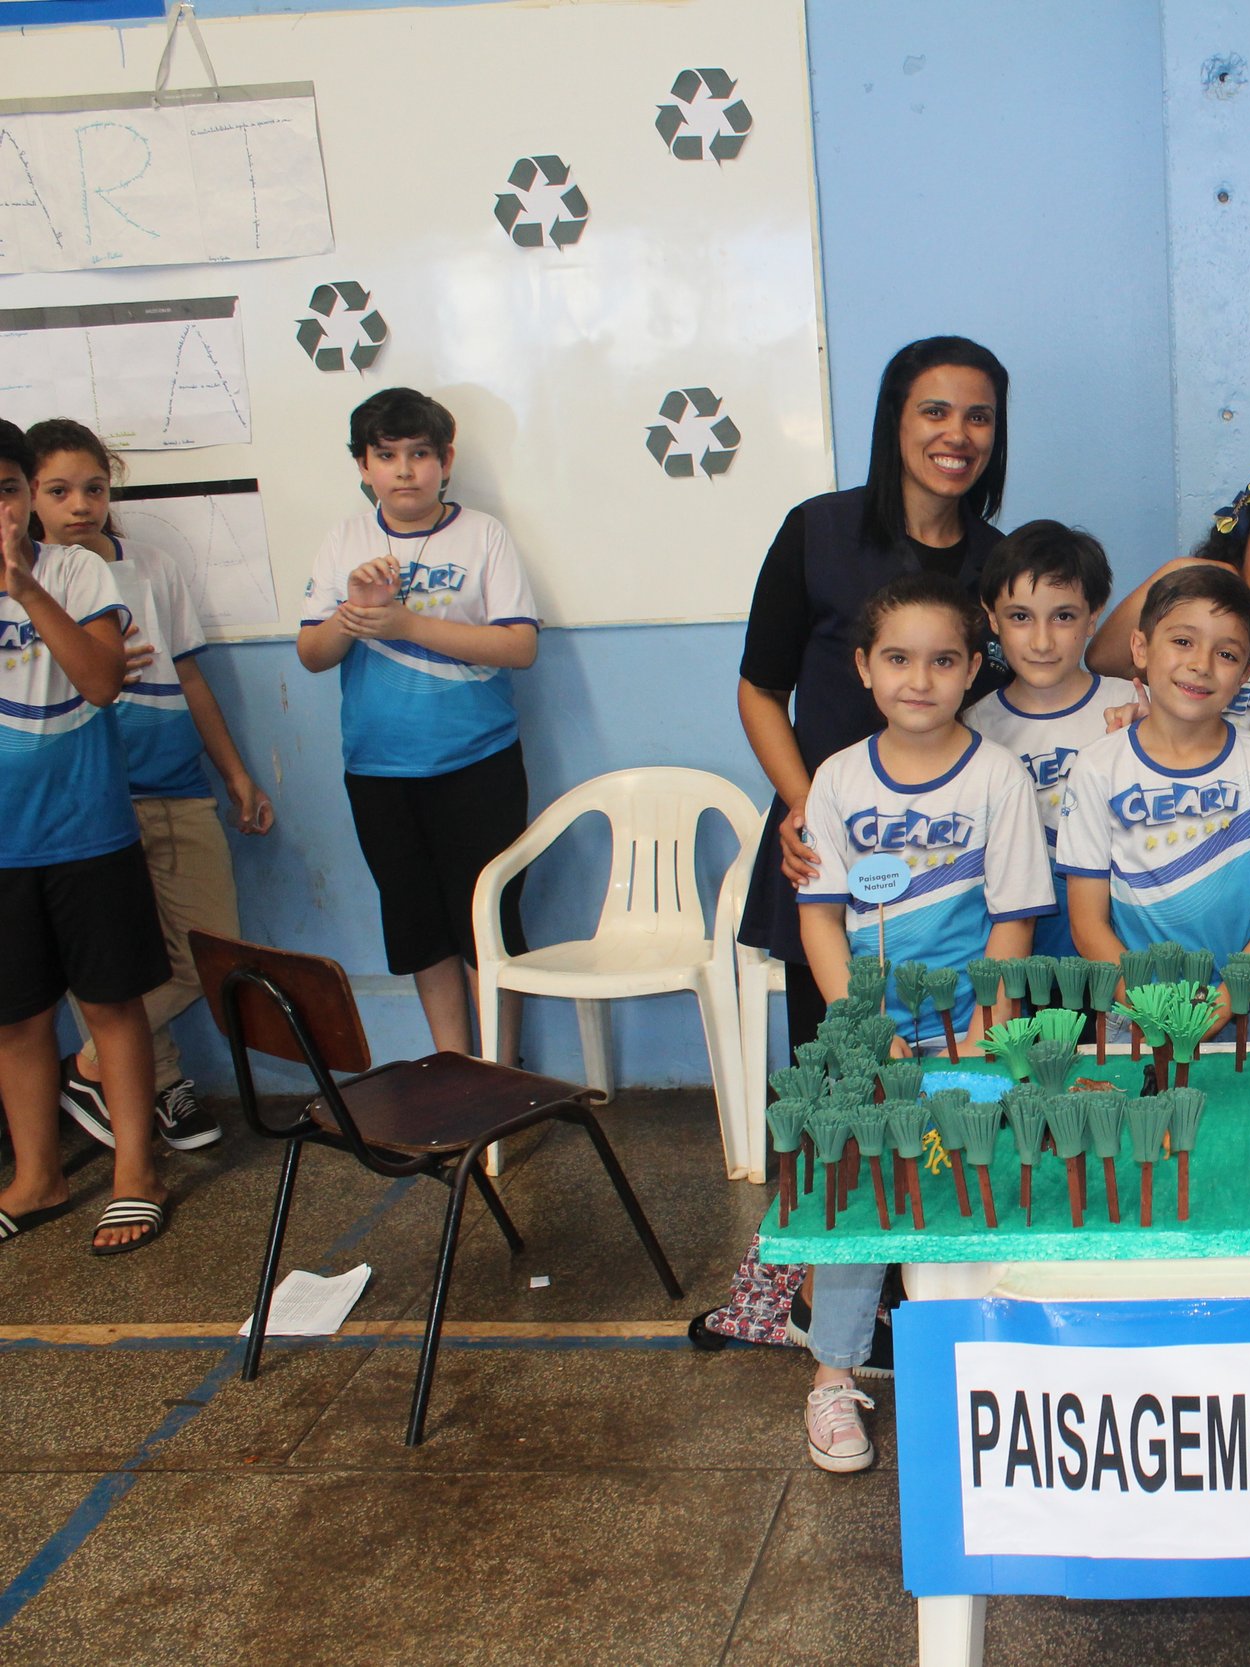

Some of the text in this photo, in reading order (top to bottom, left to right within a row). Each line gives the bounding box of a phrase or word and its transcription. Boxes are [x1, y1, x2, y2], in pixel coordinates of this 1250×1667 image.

[1120, 781, 1240, 823] CEART
[851, 812, 976, 850] CEART
[858, 871, 900, 883] Paisagem
[864, 880, 897, 892] Natural
